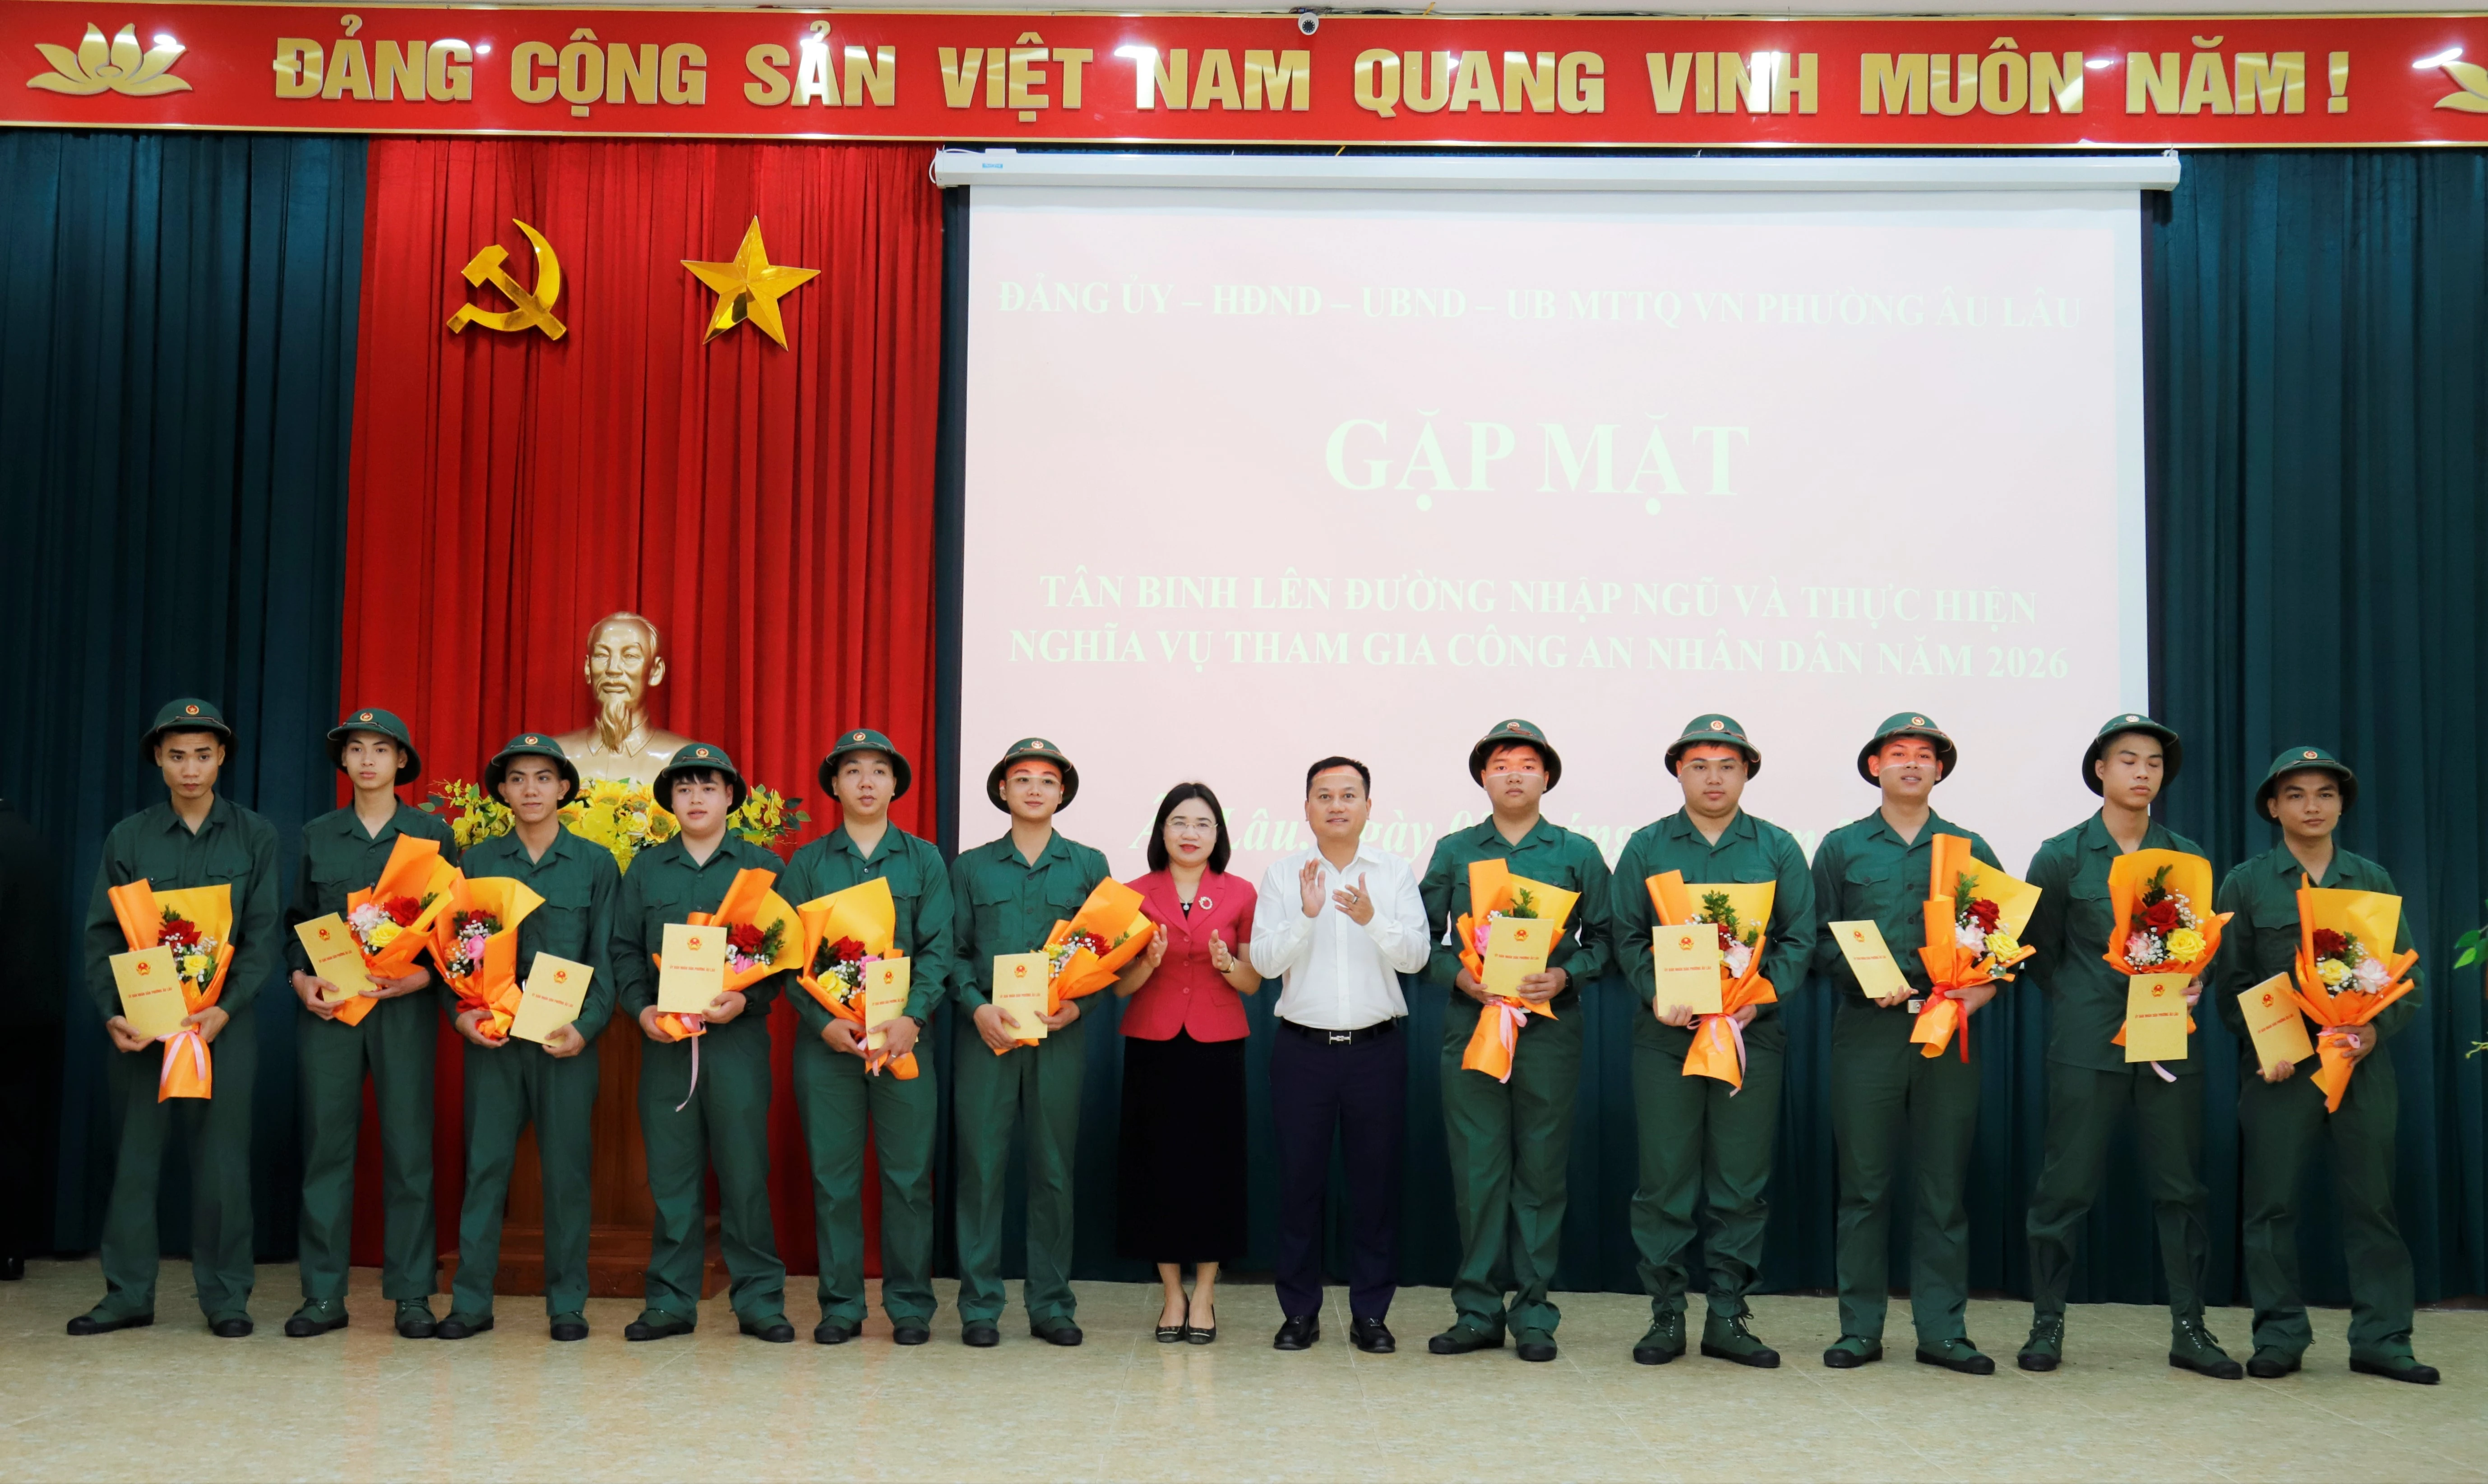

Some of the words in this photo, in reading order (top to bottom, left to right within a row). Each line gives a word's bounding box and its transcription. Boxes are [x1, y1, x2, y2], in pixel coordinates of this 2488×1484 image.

[273, 14, 472, 101] ĐẢNG
[511, 28, 707, 117] CỘNG
[744, 20, 895, 107] SẢN
[938, 32, 1093, 122] VIỆT
[1135, 47, 1310, 111] NAM
[1355, 48, 1604, 117] QUANG
[1646, 51, 1819, 114] VINH
[1860, 37, 2083, 115] MUÔN
[2126, 36, 2305, 114] NĂM
[2327, 51, 2349, 113] !
[998, 272, 1109, 313] ĐẢNG
[1122, 273, 1175, 314] ỦY
[1213, 284, 1323, 315] HĐND
[1363, 286, 1467, 318] UBND
[1507, 289, 1556, 319] UB
[1569, 290, 1683, 328] MTTQ
[1693, 291, 1744, 322] VN
[1757, 286, 1924, 325] PHƯỜNG
[1940, 286, 1989, 327] ÂU
[2003, 286, 2080, 328] LÂU
[1326, 409, 1516, 511] GẶP
[1536, 411, 1749, 516] MẶT
[1040, 564, 1124, 607] TÂN
[1138, 576, 1236, 608] BINH
[1253, 567, 1331, 608] LÊN
[1346, 570, 1495, 612] ĐƯỜNG
[1509, 577, 1623, 623] NHẬP
[1634, 576, 1719, 616] NGŨ
[1734, 576, 1789, 617] VÀ
[1801, 583, 1921, 628] THỰC
[1935, 585, 2036, 632] HIỆN
[1008, 622, 1147, 662] NGHĨA
[1157, 631, 1212, 673] VỤ
[1226, 631, 1349, 664] THAM
[1363, 633, 1436, 665] GIA
[1448, 623, 1566, 668] CÔNG
[1577, 636, 1632, 668] AN
[1648, 629, 1763, 670] NHÂN
[1778, 631, 1863, 673] DÂN
[1877, 635, 1974, 677] NĂM
[1988, 646, 2069, 678] 2026
